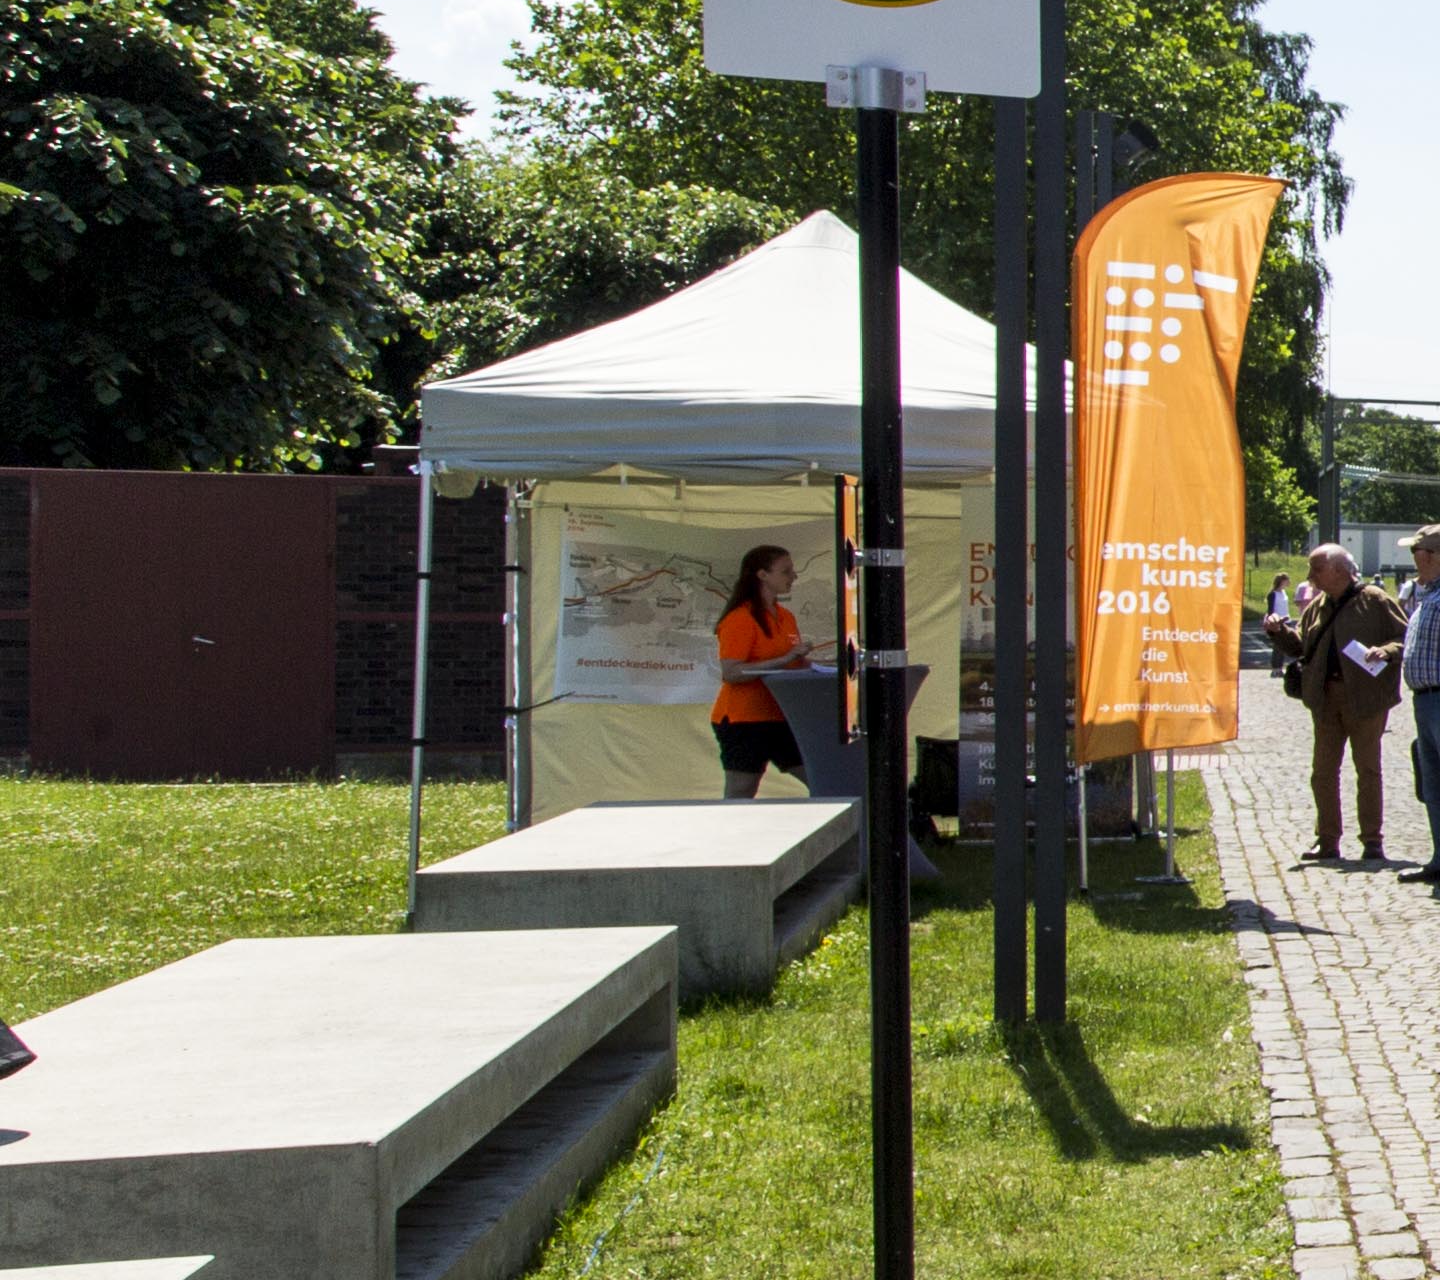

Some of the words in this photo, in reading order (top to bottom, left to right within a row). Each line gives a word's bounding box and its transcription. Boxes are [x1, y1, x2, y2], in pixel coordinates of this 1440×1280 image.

[1102, 536, 1230, 563] emscher
[1141, 563, 1227, 589] kunst
[1097, 590, 1171, 615] 2016
[1142, 626, 1219, 643] Entdecke
[1142, 647, 1168, 662] die
[576, 656, 695, 671] #entdeckediekunst
[1141, 667, 1189, 684] Kunst
